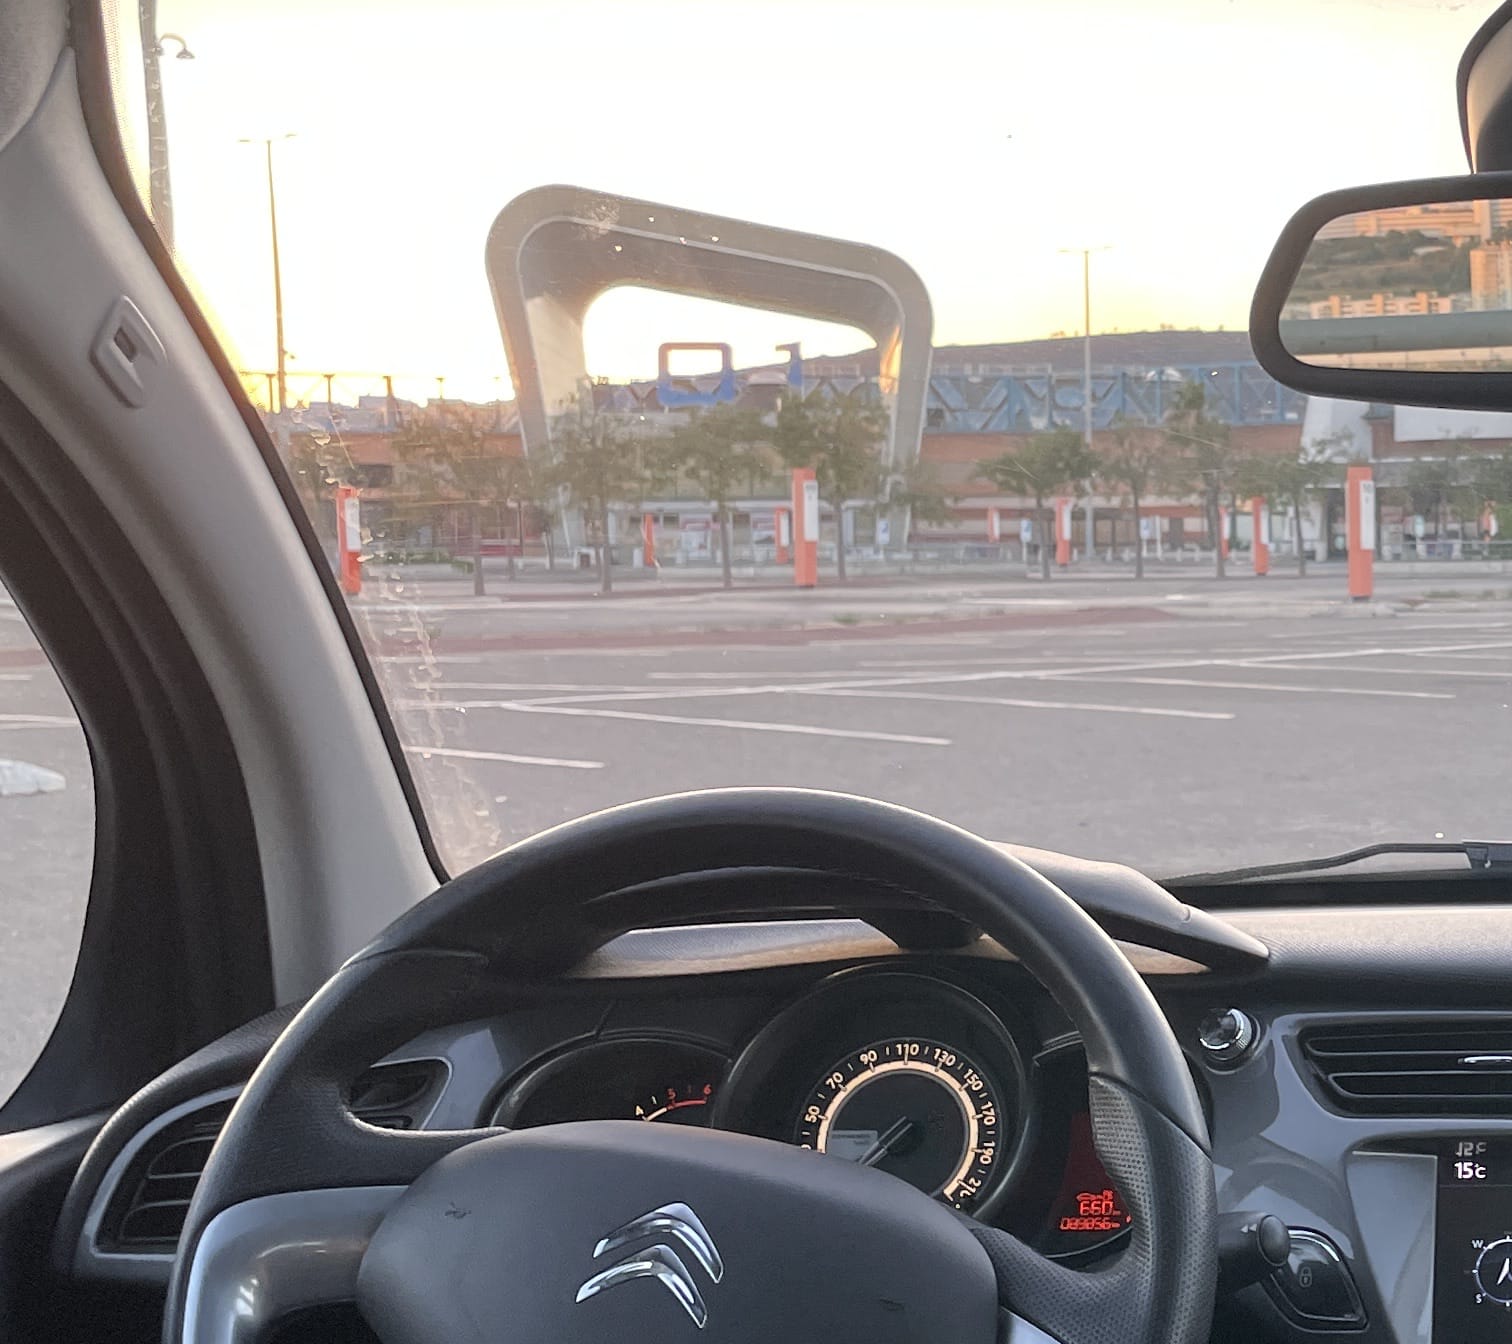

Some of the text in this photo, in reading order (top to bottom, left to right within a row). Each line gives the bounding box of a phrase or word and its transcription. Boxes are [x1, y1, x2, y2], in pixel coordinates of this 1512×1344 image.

[860, 1050, 878, 1065] 90
[896, 1043, 920, 1056] 110
[933, 1047, 956, 1067] 130
[825, 1071, 844, 1090] 70
[963, 1068, 984, 1092] 150
[804, 1105, 820, 1124] 50
[980, 1101, 996, 1126] 170
[978, 1140, 996, 1165] 190
[1471, 1239, 1484, 1249] W
[1475, 1293, 1483, 1304] S
